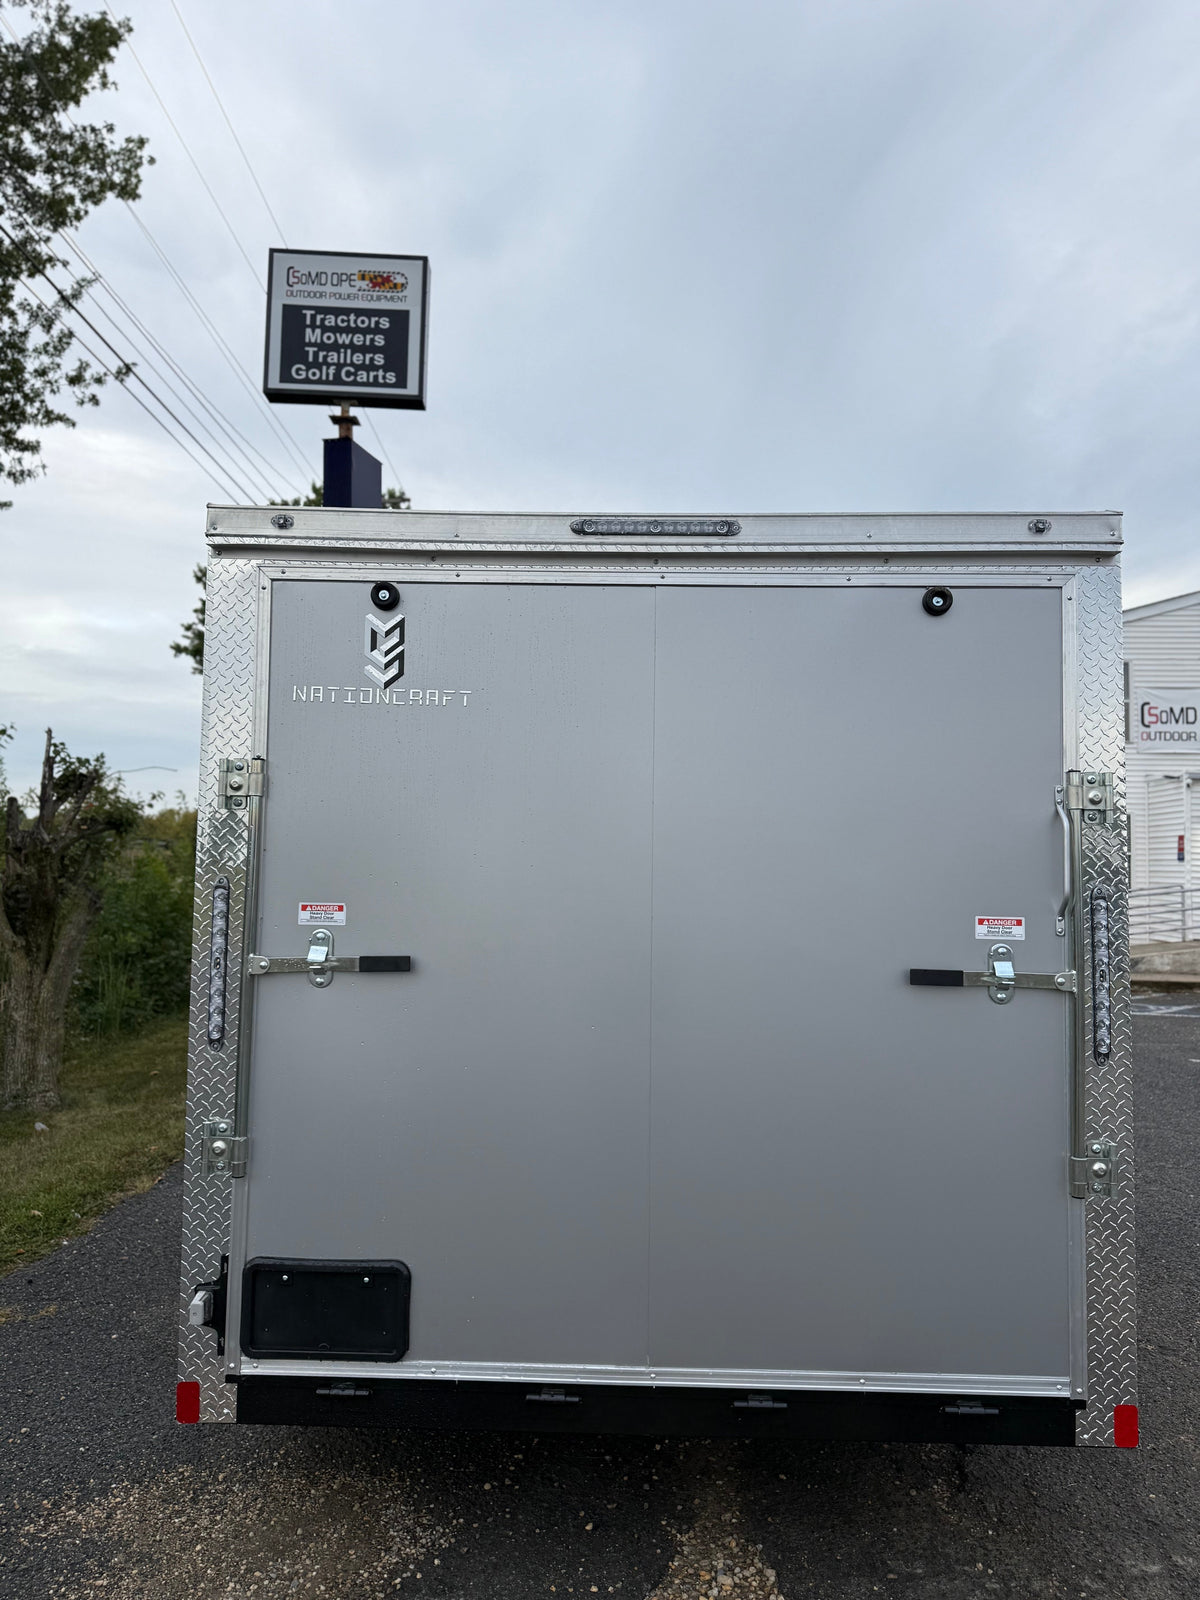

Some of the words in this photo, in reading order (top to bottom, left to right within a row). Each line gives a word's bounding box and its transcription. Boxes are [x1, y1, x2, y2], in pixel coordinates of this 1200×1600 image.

[331, 272, 356, 288] OPE
[286, 289, 327, 300] OUTDOOR
[328, 291, 359, 301] POWER
[361, 293, 408, 304] EQUIPMENT
[302, 309, 390, 329] Tractors
[304, 328, 385, 346] Mowers
[304, 346, 385, 365] Trailers
[291, 364, 336, 381] Golf
[341, 366, 397, 384] Carts
[292, 685, 472, 707] NATIONCRAFT
[1140, 731, 1198, 741] OUTDOOR
